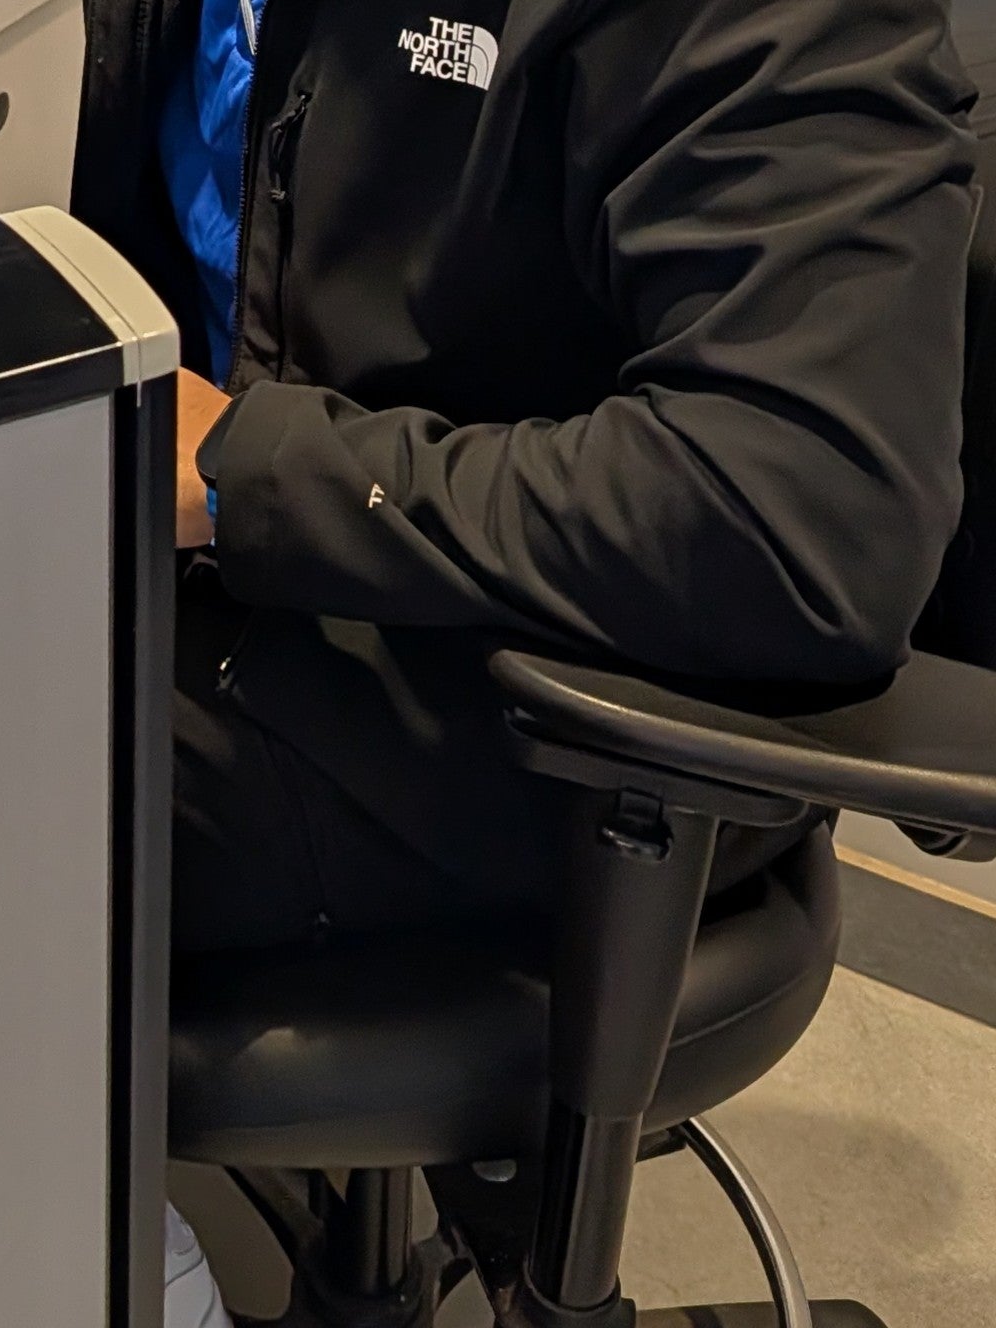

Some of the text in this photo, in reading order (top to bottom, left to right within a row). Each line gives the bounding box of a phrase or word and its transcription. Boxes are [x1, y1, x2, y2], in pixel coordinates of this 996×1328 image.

[429, 17, 473, 43] THE
[397, 28, 471, 63] NORTH
[410, 54, 468, 83] FACE
